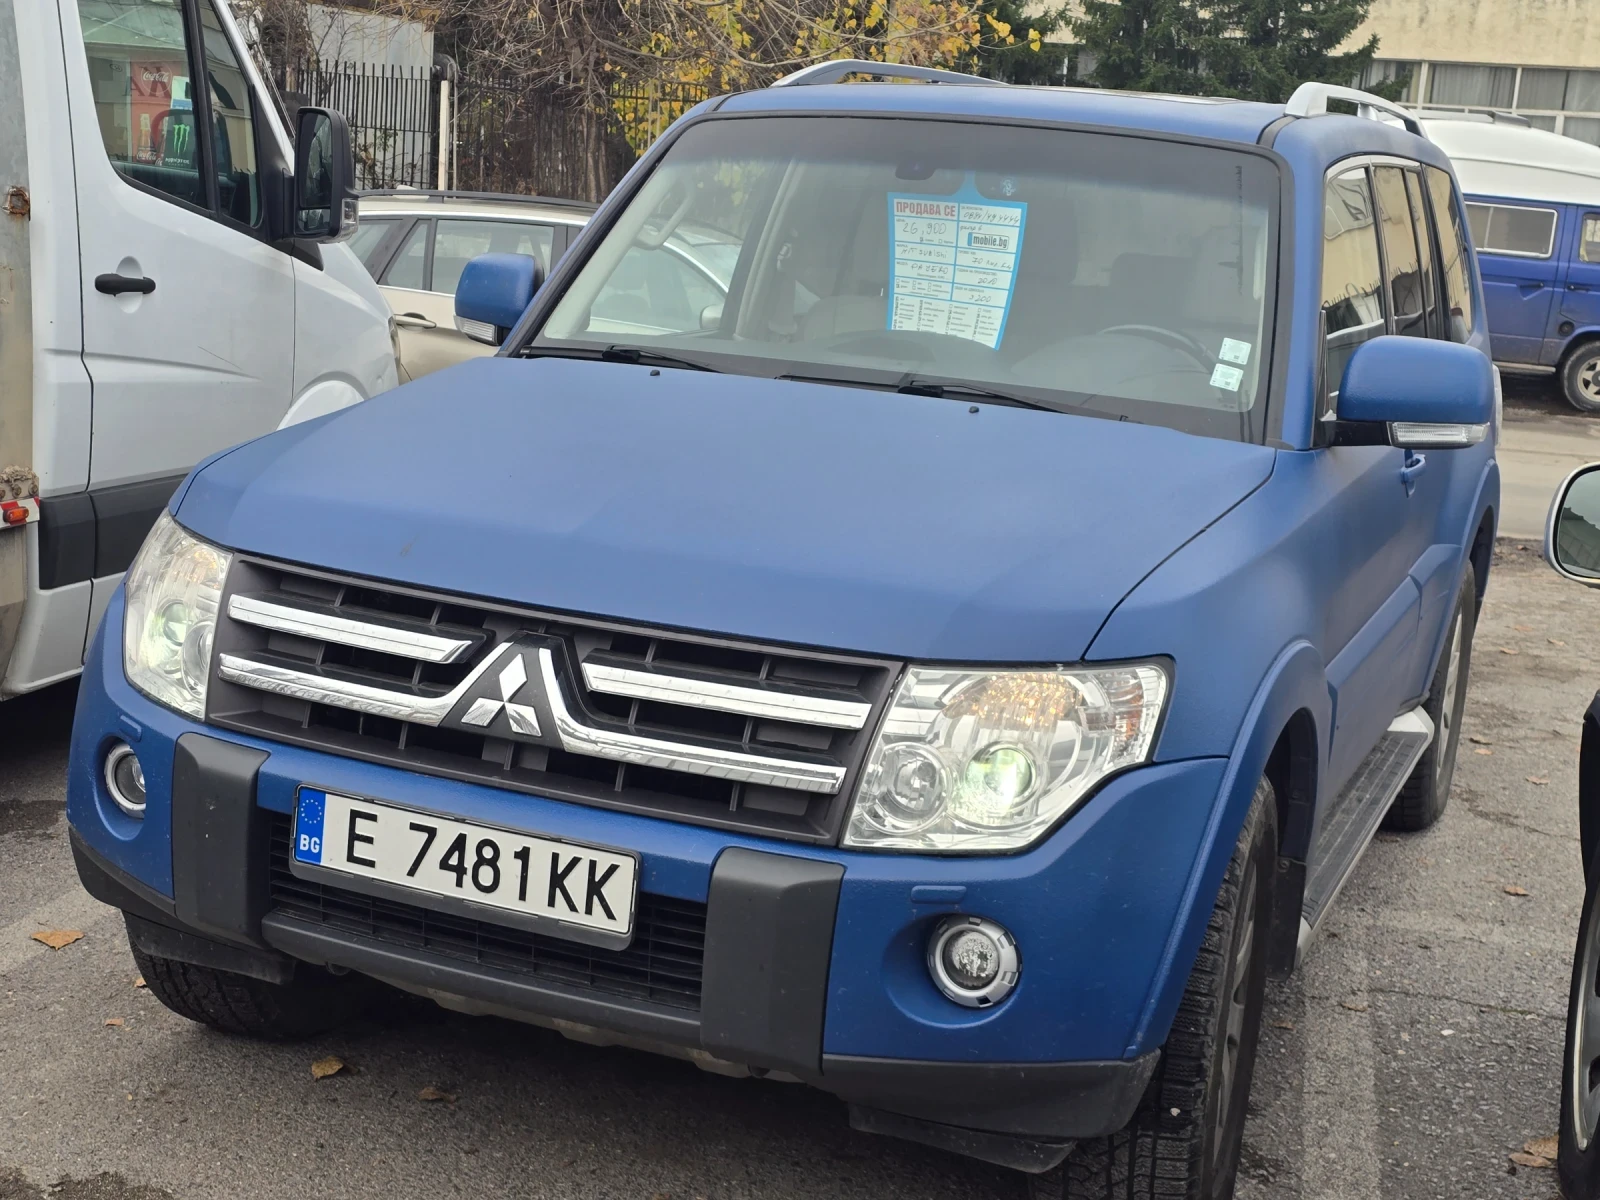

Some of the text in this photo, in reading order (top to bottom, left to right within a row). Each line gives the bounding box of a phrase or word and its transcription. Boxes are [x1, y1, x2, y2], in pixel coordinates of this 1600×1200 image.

[896, 201, 941, 216] ПРОДАВА
[943, 205, 956, 217] СЕ
[972, 235, 1008, 249] mobile.bg
[299, 834, 320, 855] BG
[346, 808, 379, 869] E
